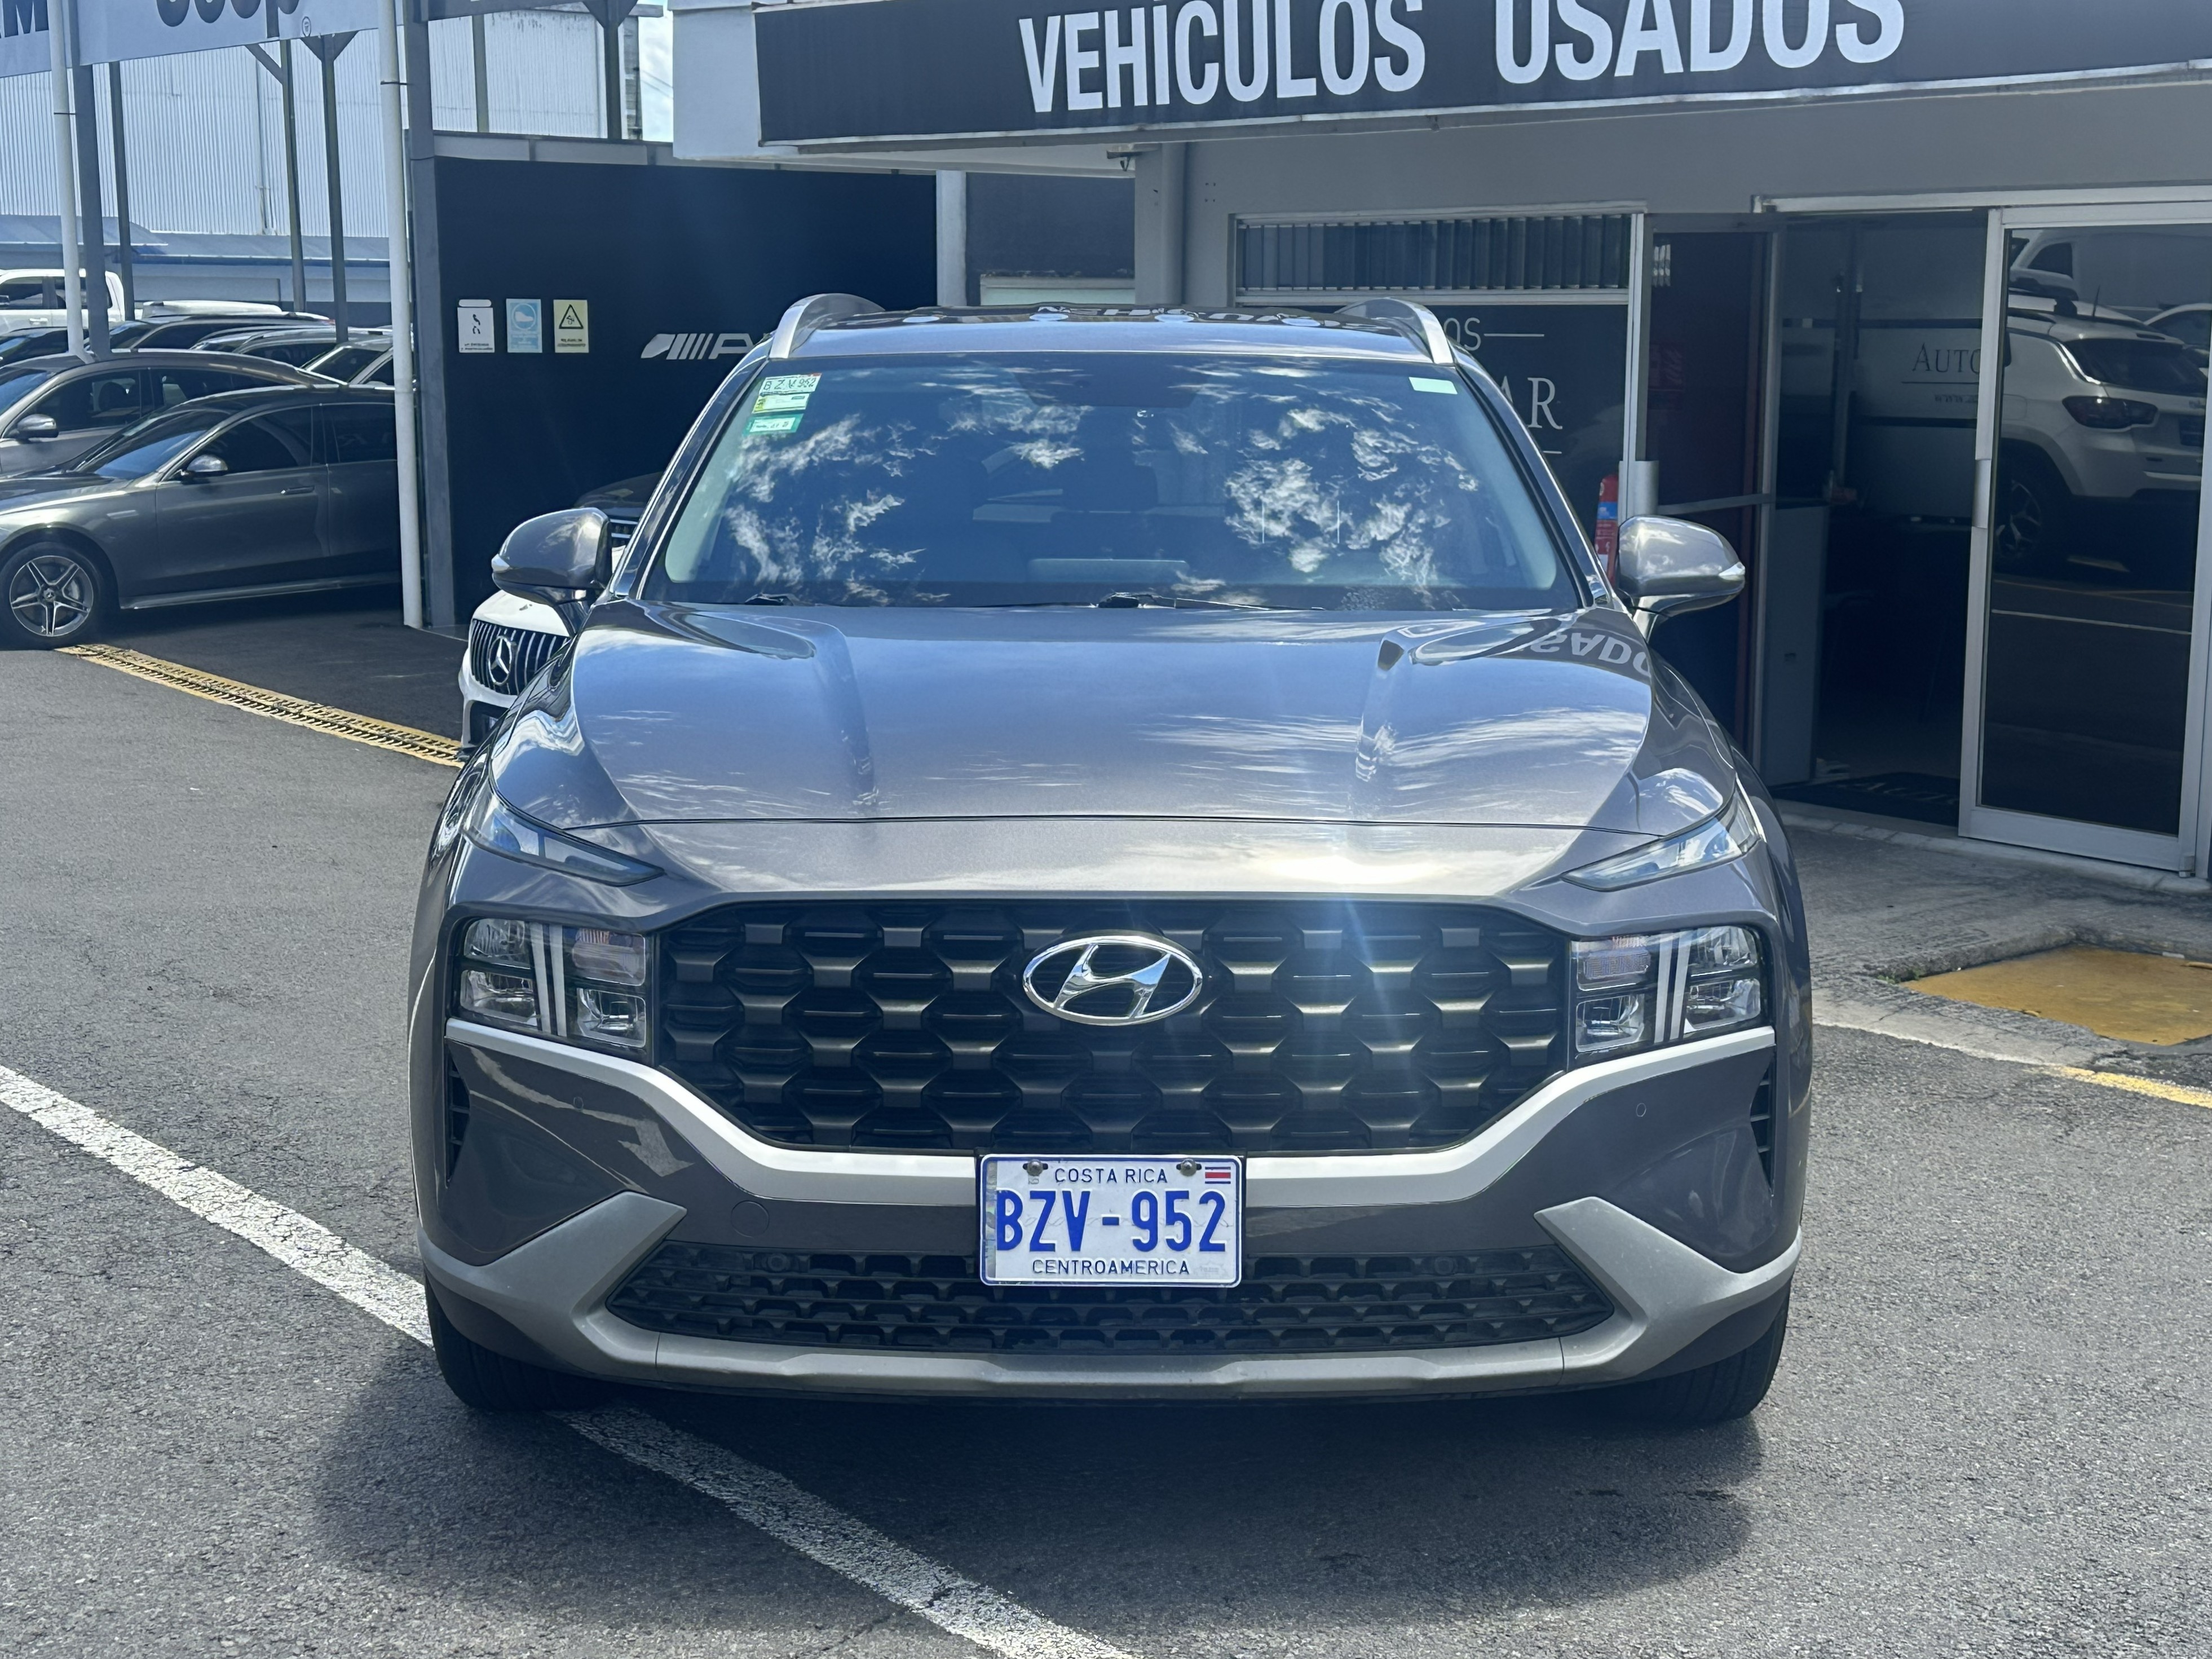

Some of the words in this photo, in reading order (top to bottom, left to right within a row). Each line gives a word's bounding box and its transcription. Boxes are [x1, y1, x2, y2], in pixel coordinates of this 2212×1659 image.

[1495, 0, 1904, 84] USADOS
[1054, 1168, 1118, 1184] COSTA
[1125, 1168, 1168, 1184] RICA
[996, 1190, 1226, 1252] BZV-952
[1032, 1259, 1190, 1276] CENTROAMERICA
